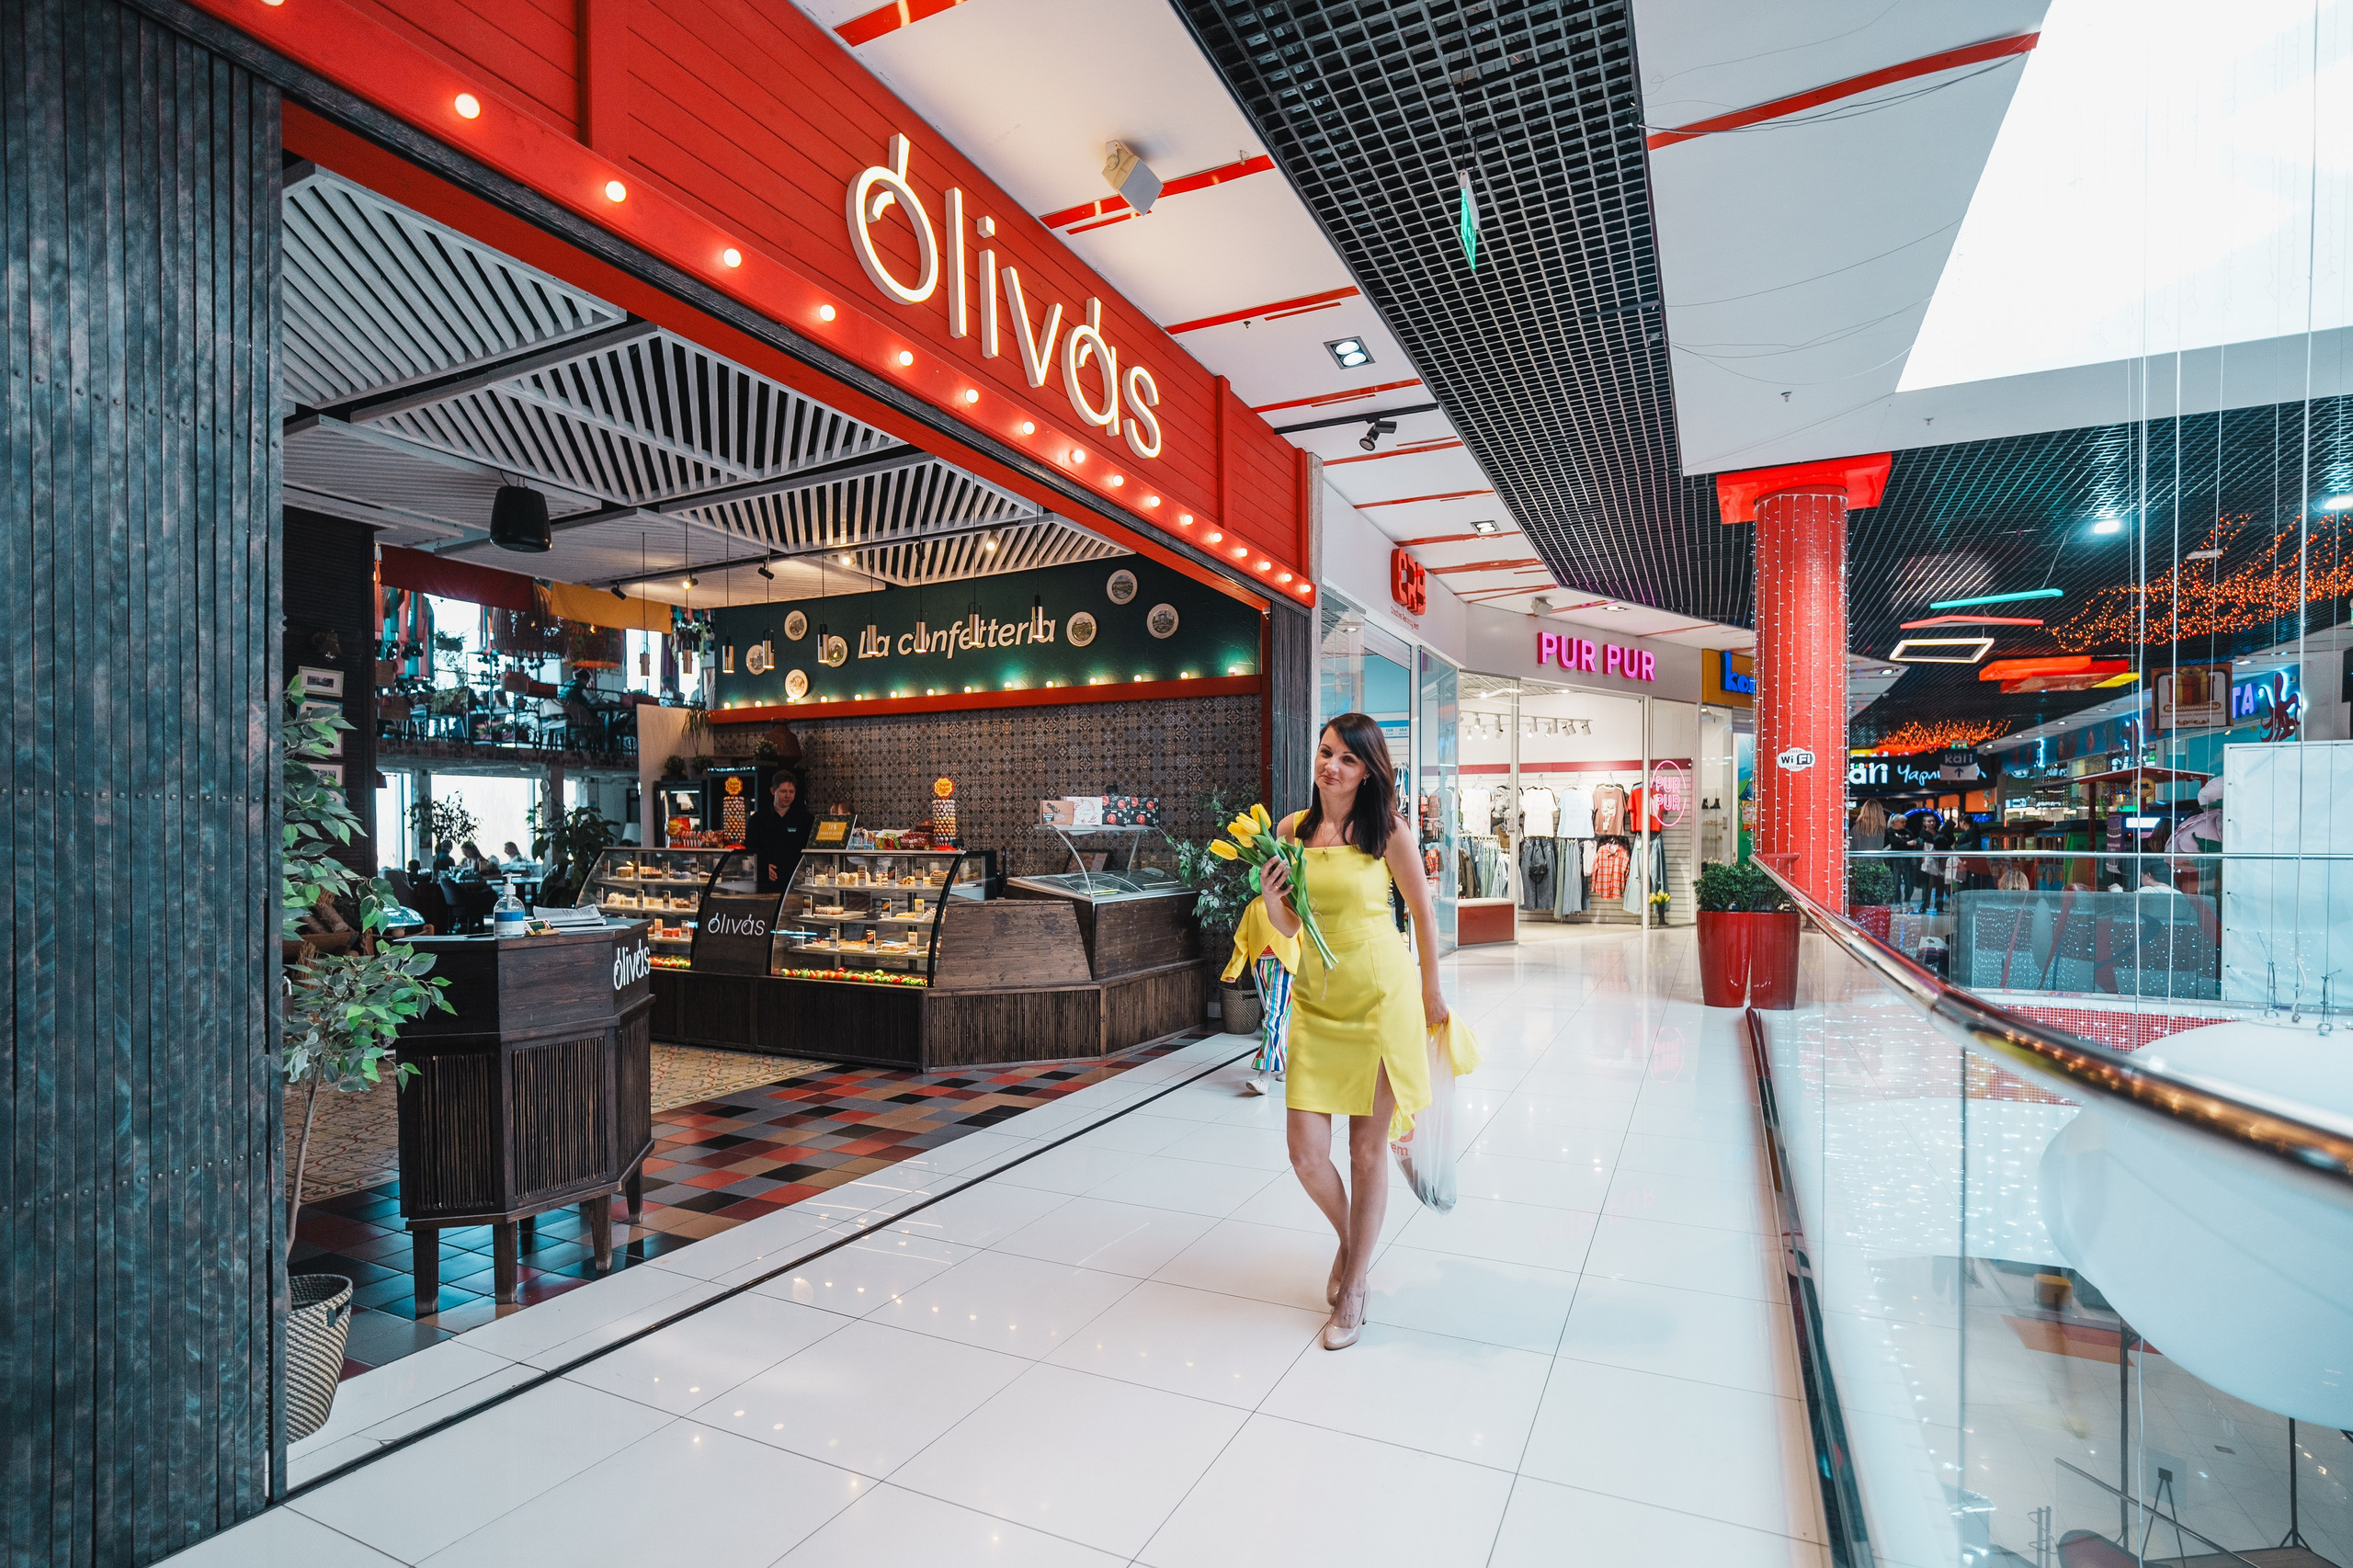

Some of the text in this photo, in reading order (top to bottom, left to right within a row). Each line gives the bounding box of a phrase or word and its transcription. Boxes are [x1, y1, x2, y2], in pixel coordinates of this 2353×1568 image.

[1537, 631, 1655, 682] PUR PUR
[1655, 776, 1681, 793] PUR
[1655, 794, 1681, 812] PUR
